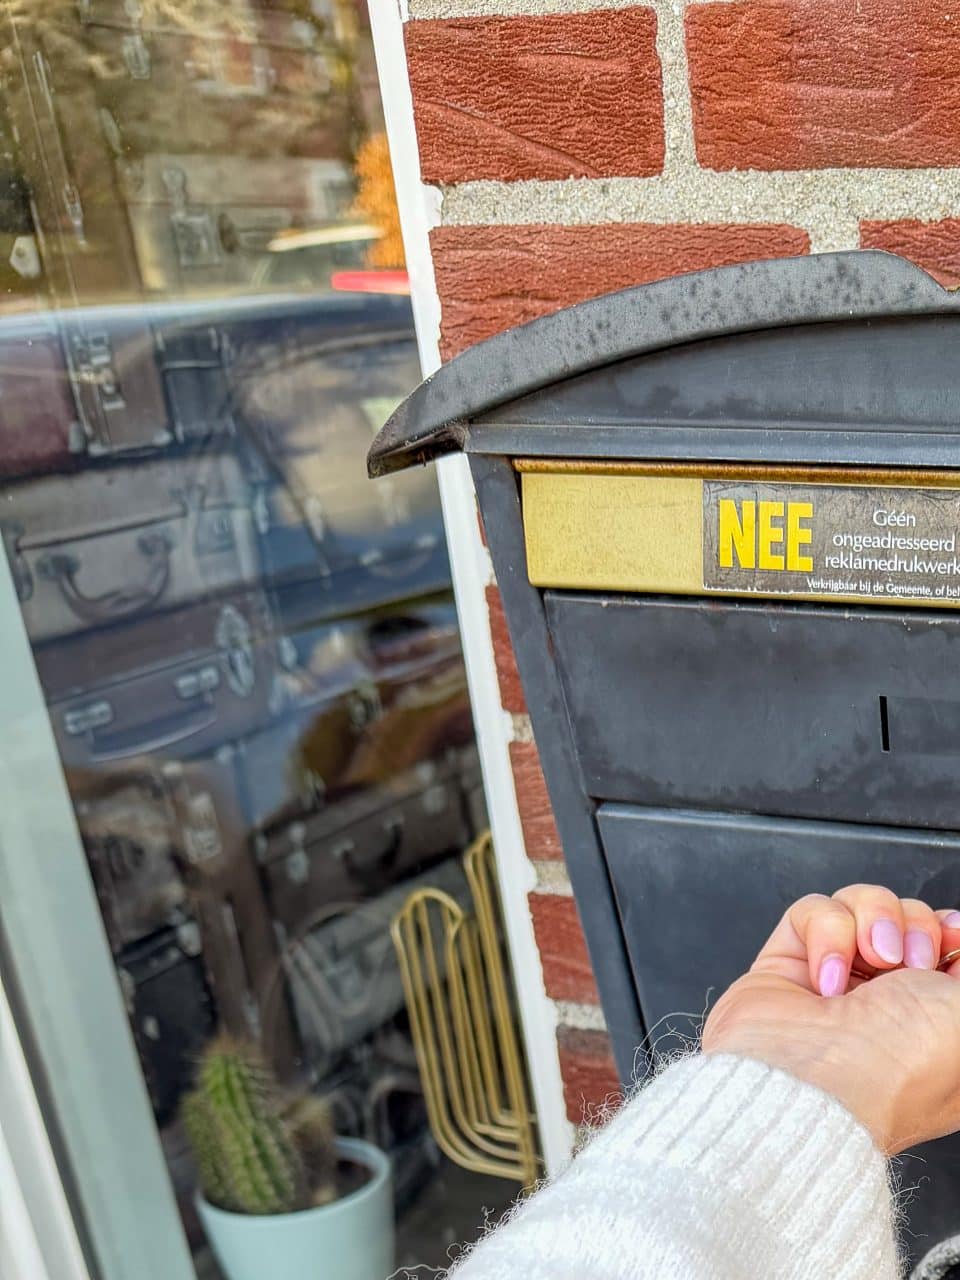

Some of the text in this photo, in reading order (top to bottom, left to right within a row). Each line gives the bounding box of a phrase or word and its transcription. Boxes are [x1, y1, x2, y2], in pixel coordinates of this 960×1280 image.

[873, 509, 916, 527] Géén
[719, 499, 814, 572] NEE
[833, 533, 955, 553] ongeadresseerd
[806, 577, 857, 591] Verkrijgbaar
[860, 580, 871, 592] bij
[873, 582, 884, 593] de
[935, 586, 944, 596] of
[946, 586, 960, 597] bel
